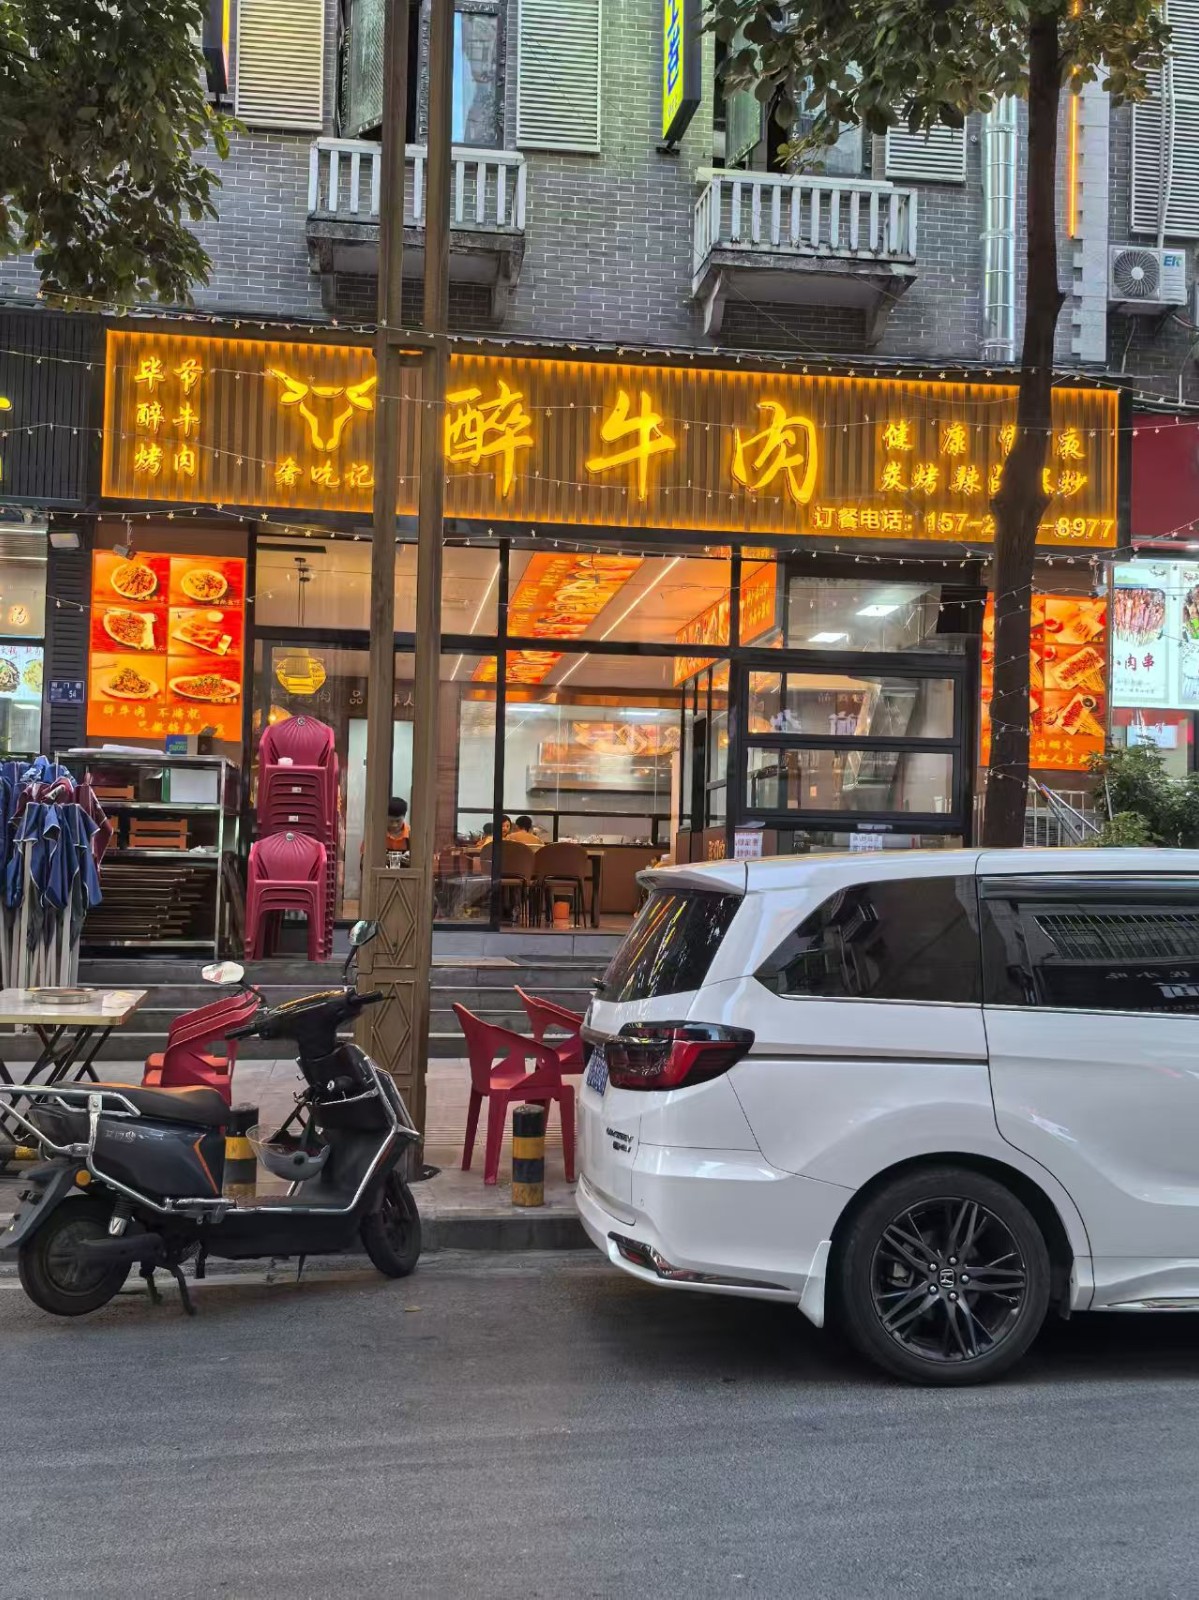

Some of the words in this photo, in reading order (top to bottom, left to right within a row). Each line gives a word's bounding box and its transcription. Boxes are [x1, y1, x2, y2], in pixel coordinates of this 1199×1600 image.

[136, 401, 201, 437] 醉牛
[134, 443, 197, 476] 烤肉
[444, 380, 818, 503] 醉牛肉
